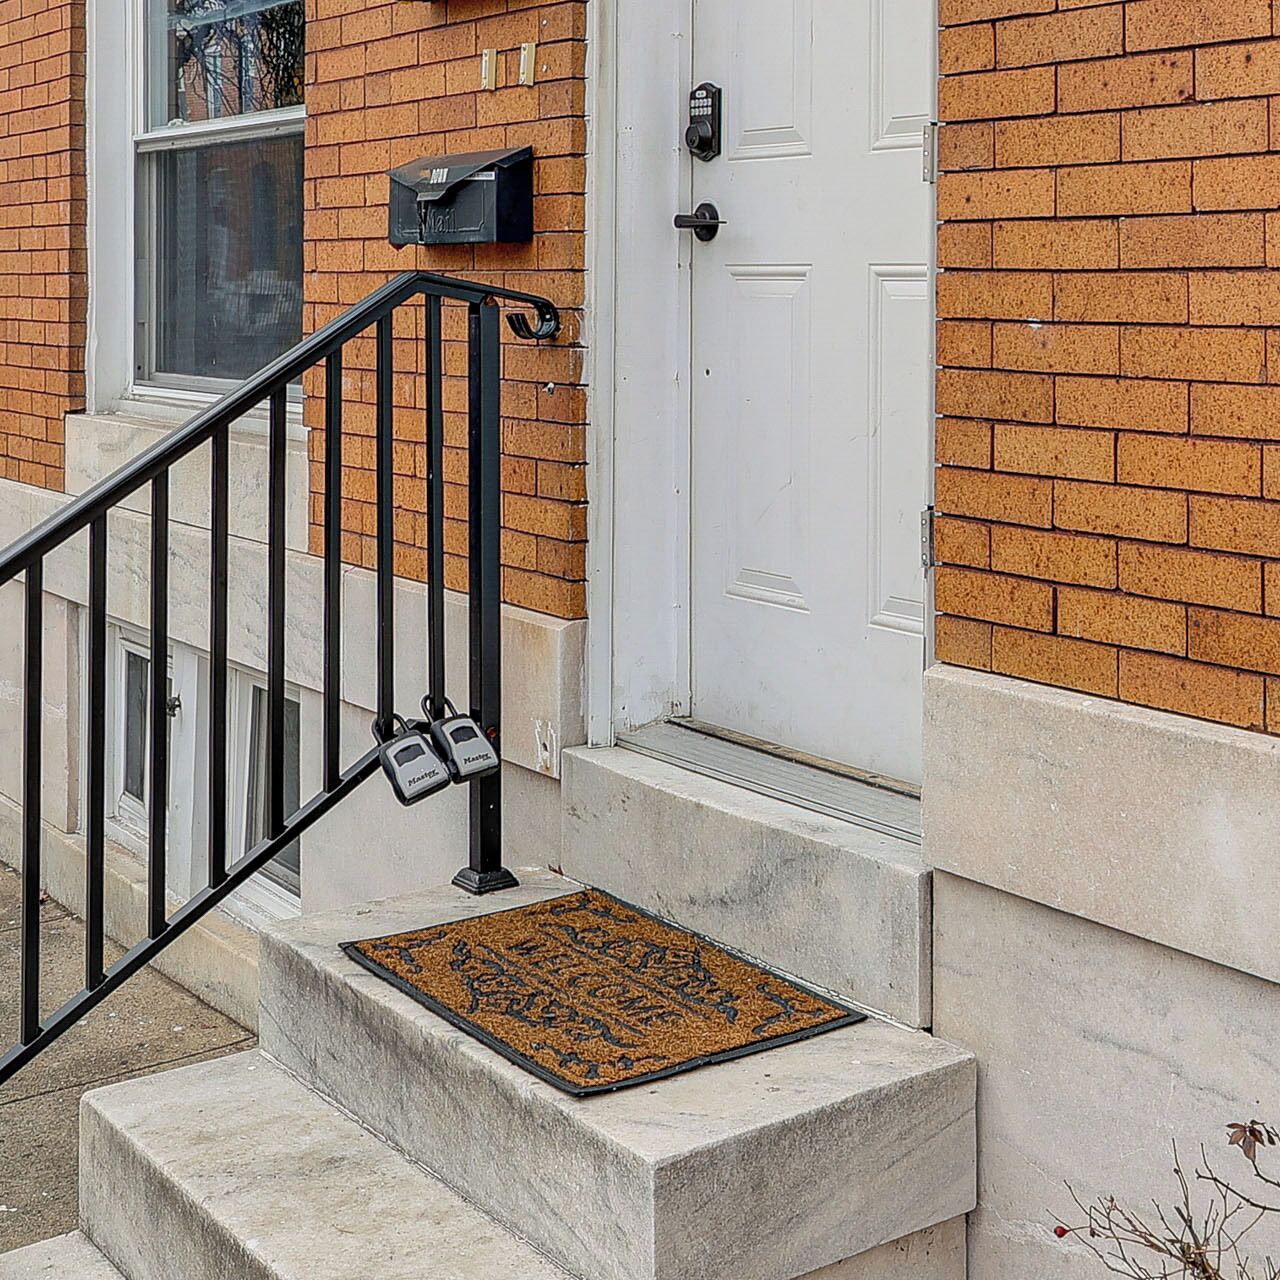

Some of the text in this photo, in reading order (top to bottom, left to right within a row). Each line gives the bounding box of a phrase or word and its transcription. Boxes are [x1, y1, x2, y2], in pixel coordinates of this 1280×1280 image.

[463, 752, 488, 765] Master
[407, 769, 436, 787] Master
[508, 938, 686, 1026] WELCOME
